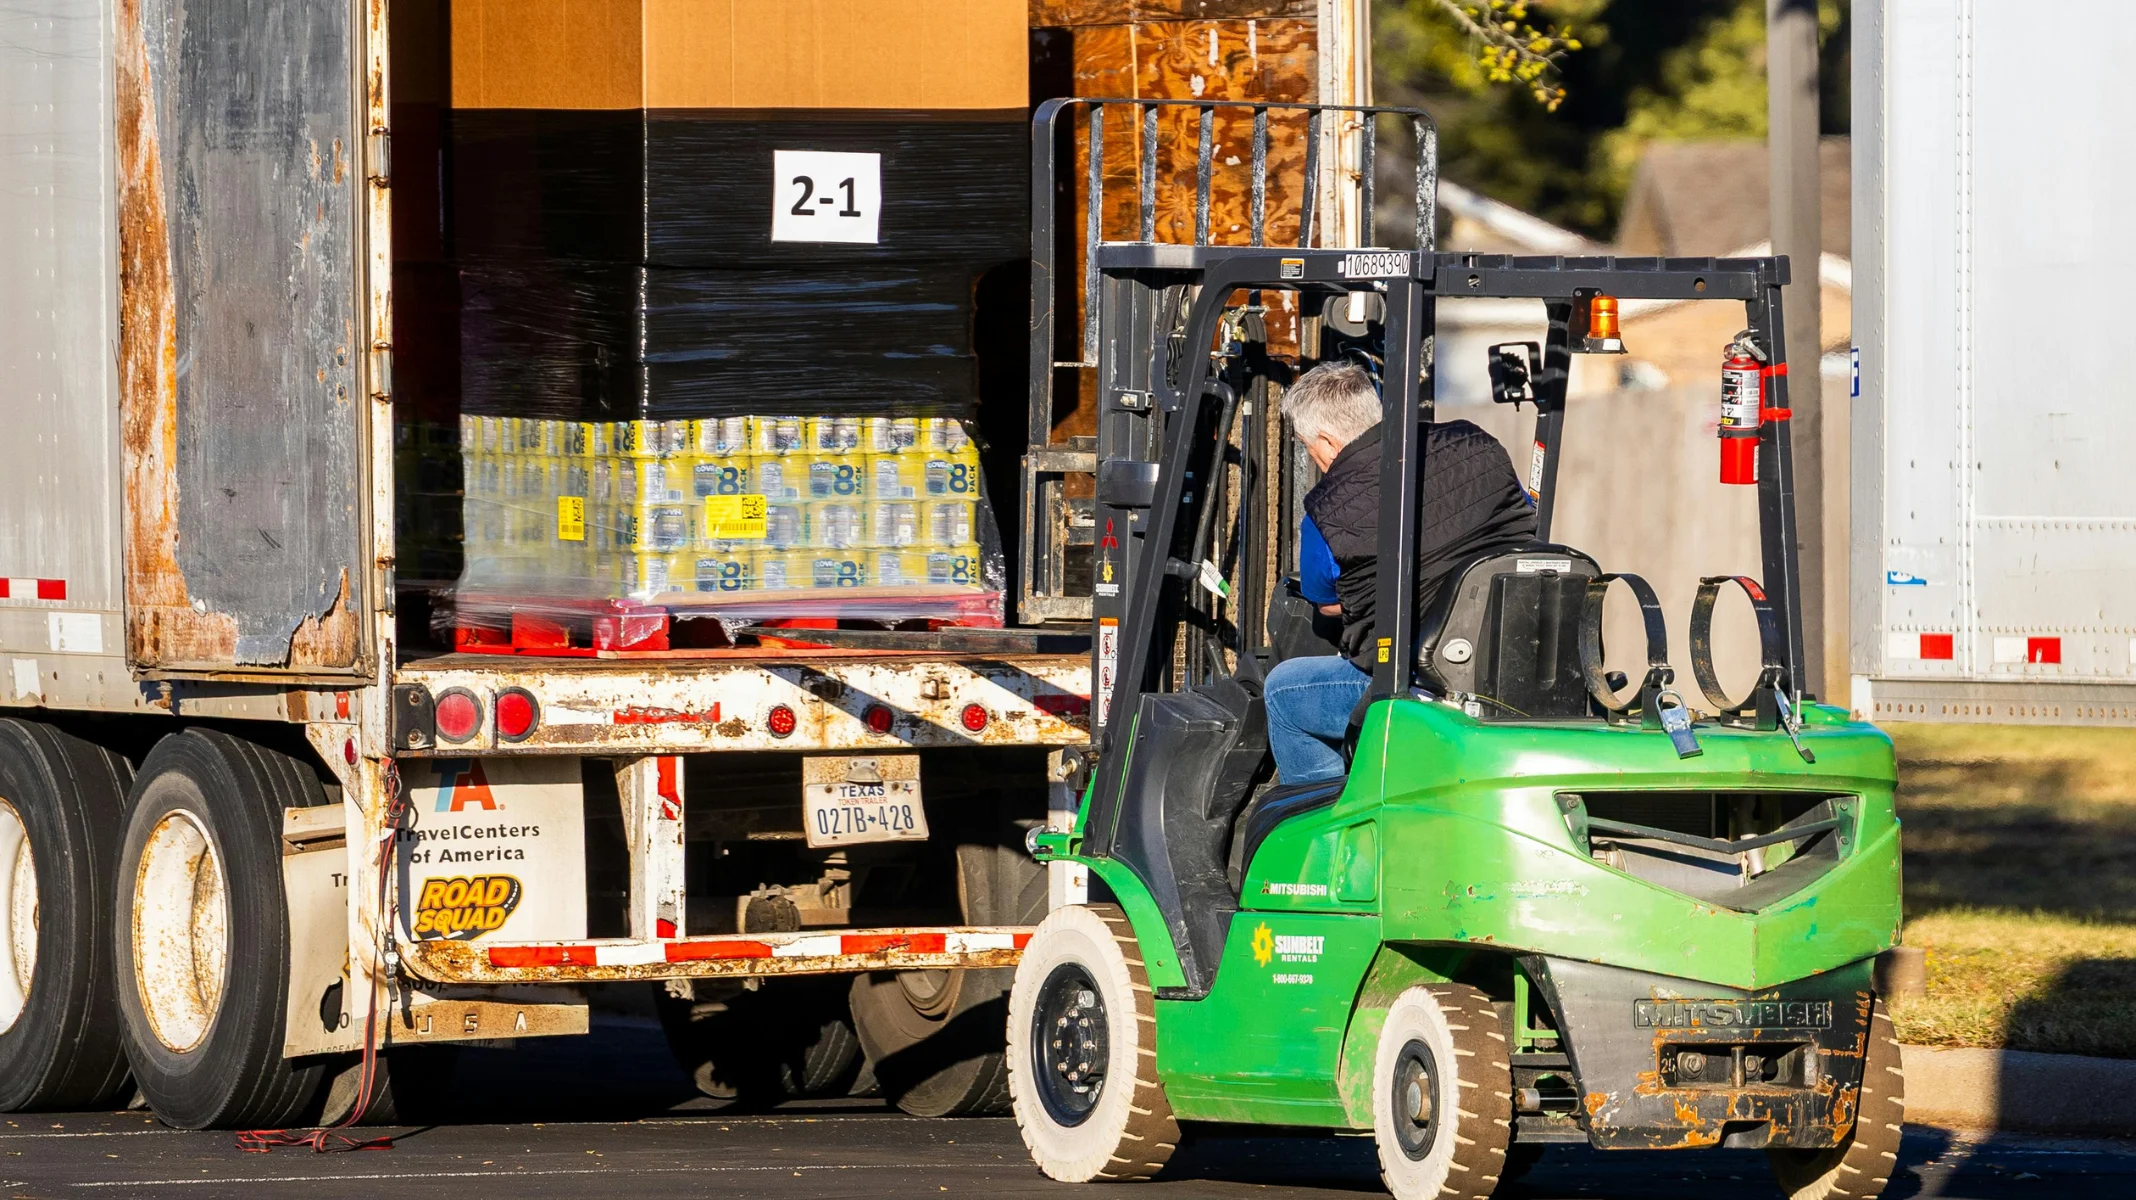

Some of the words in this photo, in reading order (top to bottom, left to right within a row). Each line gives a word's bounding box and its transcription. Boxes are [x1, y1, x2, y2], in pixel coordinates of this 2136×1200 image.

[790, 175, 862, 218] 2-1
[1347, 254, 1409, 276] 10689390
[718, 467, 739, 495] 8
[833, 465, 855, 495] 8
[949, 464, 968, 493] 8
[720, 562, 741, 591] 8
[837, 561, 857, 587] 8
[952, 555, 969, 585] 8
[431, 758, 497, 812] TA
[840, 785, 885, 797] TEXAS
[860, 796, 888, 805] TRAILER
[394, 823, 540, 842] TravelCenters
[411, 849, 431, 863] of
[439, 846, 525, 863] America
[421, 879, 511, 909] ROAD
[1270, 883, 1327, 896] MITSUBISHI
[415, 908, 506, 937] SQUAD
[1275, 935, 1325, 954] SUNBELT
[1281, 954, 1318, 963] RENTALS
[1637, 1002, 1830, 1027] MITSUBISHI
